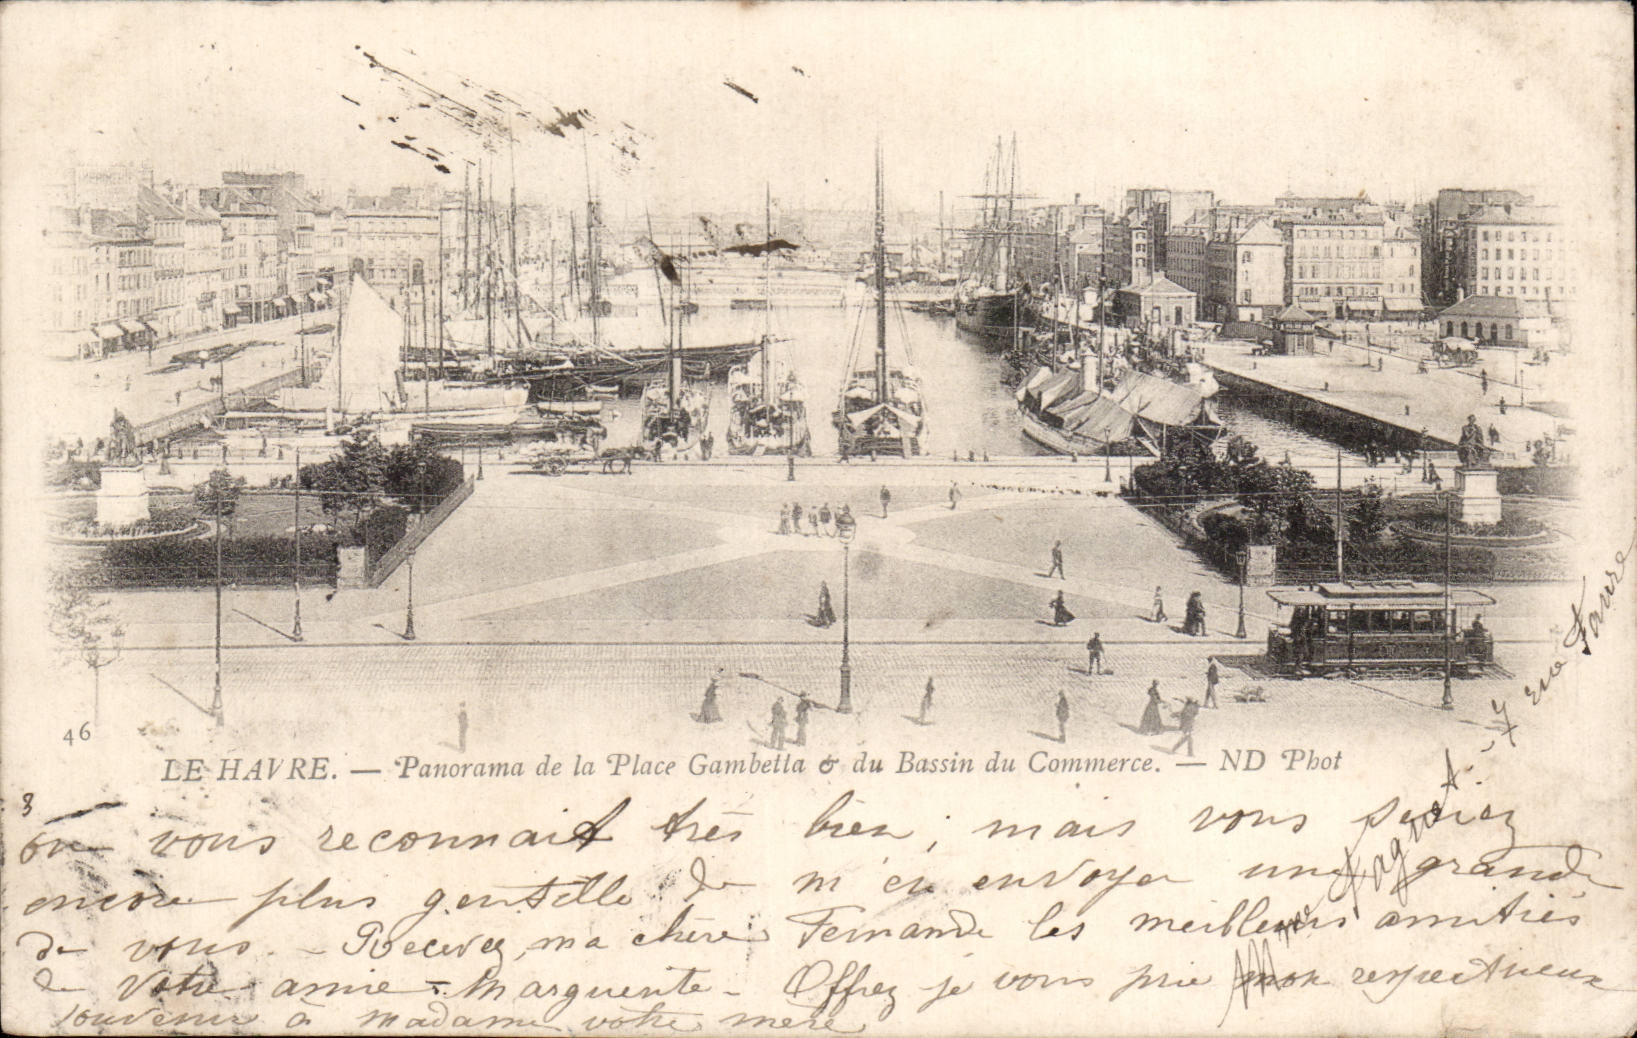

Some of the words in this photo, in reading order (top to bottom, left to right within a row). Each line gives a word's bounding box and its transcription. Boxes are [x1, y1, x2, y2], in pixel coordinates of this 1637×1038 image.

[149, 830, 276, 858] vous
[972, 796, 1136, 840] mais
[1190, 805, 1309, 834] vous
[24, 891, 237, 916] encore
[228, 874, 377, 933] plus
[683, 856, 757, 902] de
[972, 858, 1193, 917] envoyer
[16, 931, 88, 961] de
[1028, 901, 1086, 941] les
[33, 967, 86, 992] de
[993, 971, 1095, 991] vous
[1108, 961, 1213, 1002] prie
